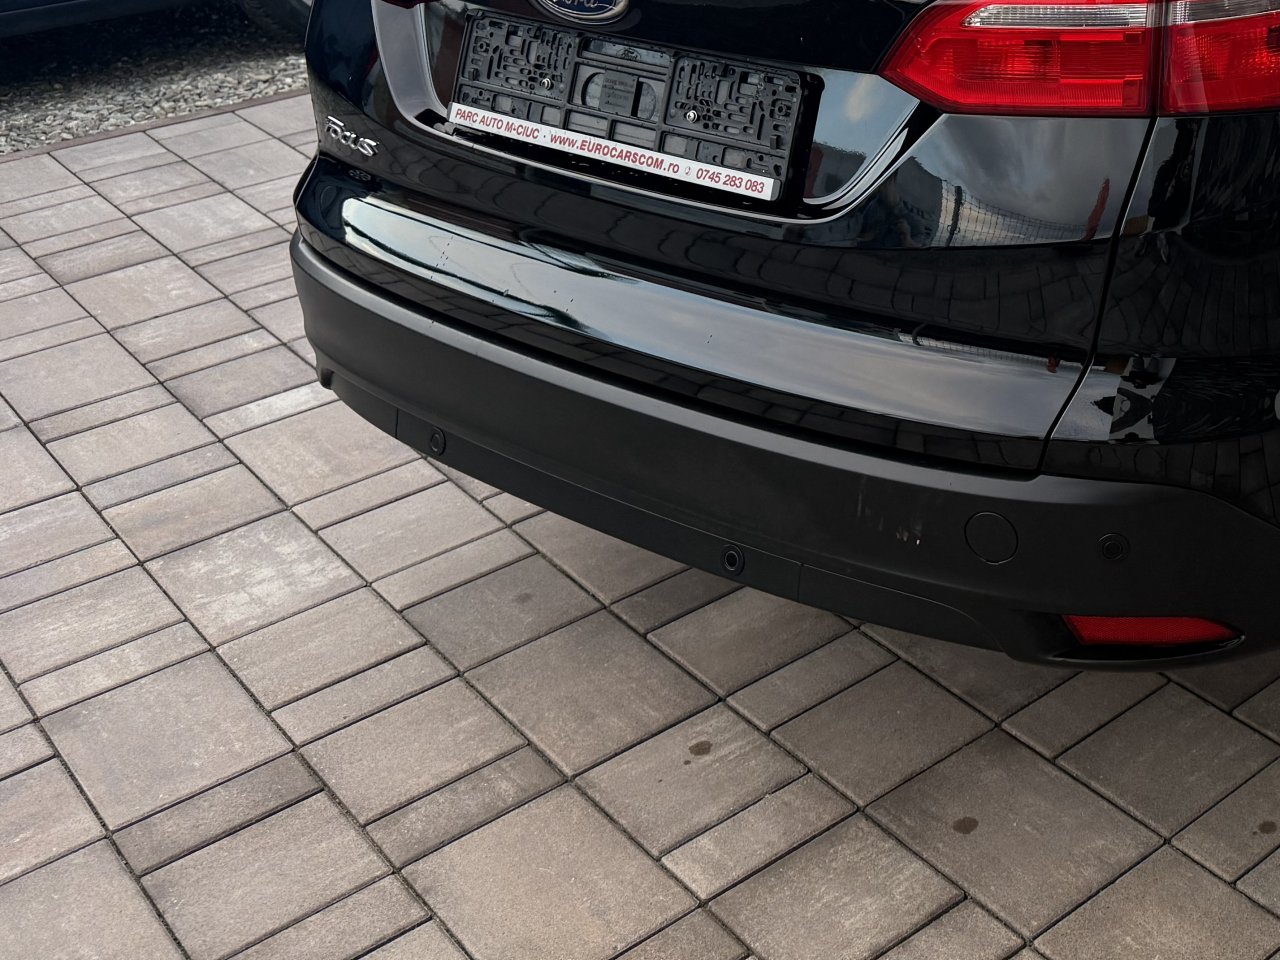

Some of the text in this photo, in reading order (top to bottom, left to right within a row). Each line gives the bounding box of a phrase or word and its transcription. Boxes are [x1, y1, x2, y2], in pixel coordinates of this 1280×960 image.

[325, 115, 379, 157] Focus
[455, 108, 479, 123] PARC
[479, 115, 504, 130] AUTO
[550, 133, 680, 174] www.EUROCARSCOM.ro
[696, 168, 722, 184] 0745
[722, 174, 743, 189] 283
[744, 179, 765, 194] 083
